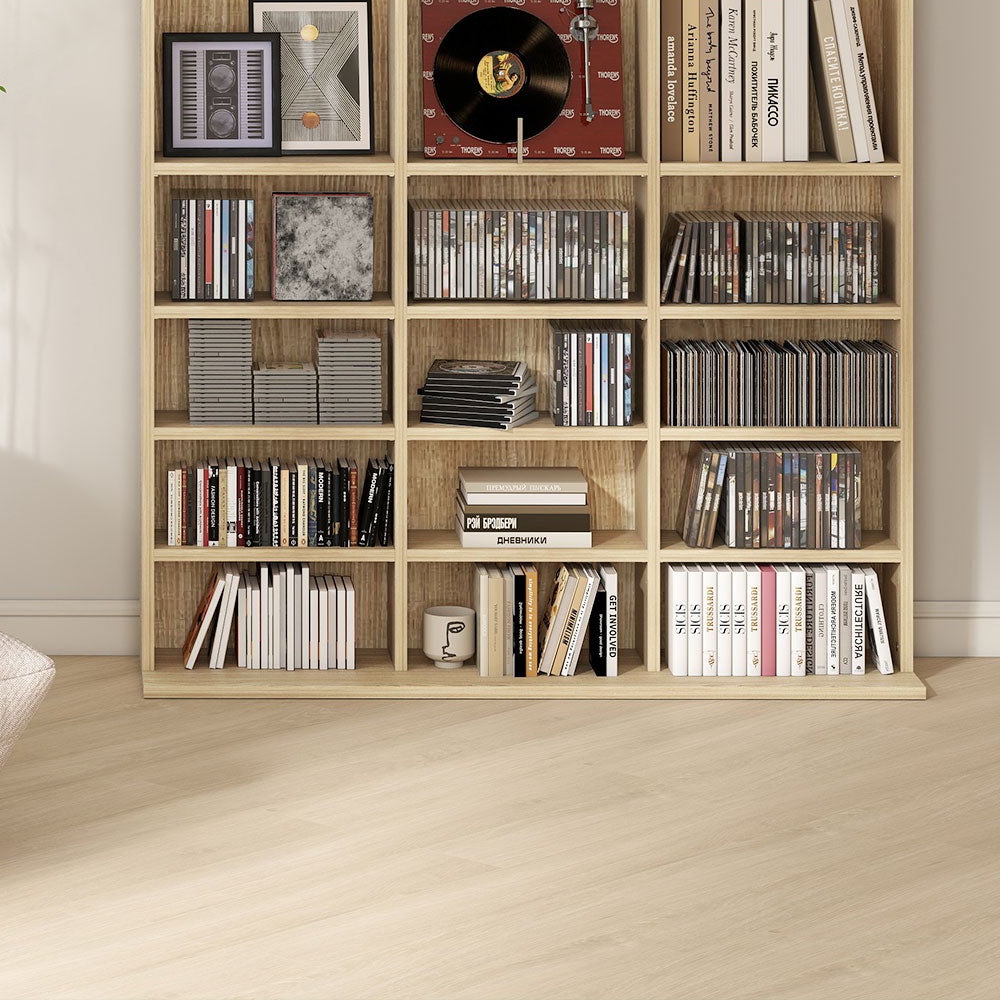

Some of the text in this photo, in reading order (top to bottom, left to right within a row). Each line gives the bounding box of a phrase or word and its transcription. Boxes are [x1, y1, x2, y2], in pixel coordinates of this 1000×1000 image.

[705, 7, 715, 29] The
[597, 33, 618, 43] THORENS
[725, 8, 738, 85] Karen McCartney
[598, 71, 620, 80] THORENS
[667, 36, 677, 122] amanda lovelace
[685, 24, 697, 133] Arianna Huffington
[701, 59, 715, 93] beyond
[857, 53, 866, 74] Метод
[823, 36, 849, 131] СПАСИТЕ КОТИКА!
[599, 109, 620, 118] THORENS
[768, 78, 778, 127] ПИКАССО
[461, 147, 483, 156] THORENS
[554, 147, 575, 156] THORENS
[600, 147, 622, 156] THORENS
[367, 472, 378, 504] MODERN
[467, 515, 517, 529] РЭЙ БРЭДБЕРИ
[676, 604, 686, 635] SICIS
[690, 604, 701, 635] SICIS
[706, 586, 714, 632] TRUSSARDI
[719, 604, 730, 635] SICIS
[734, 604, 745, 635] SICIS
[778, 604, 789, 635] SICIS
[562, 608, 577, 645] MINIMALISM
[609, 595, 617, 658] GET INVOLVED
